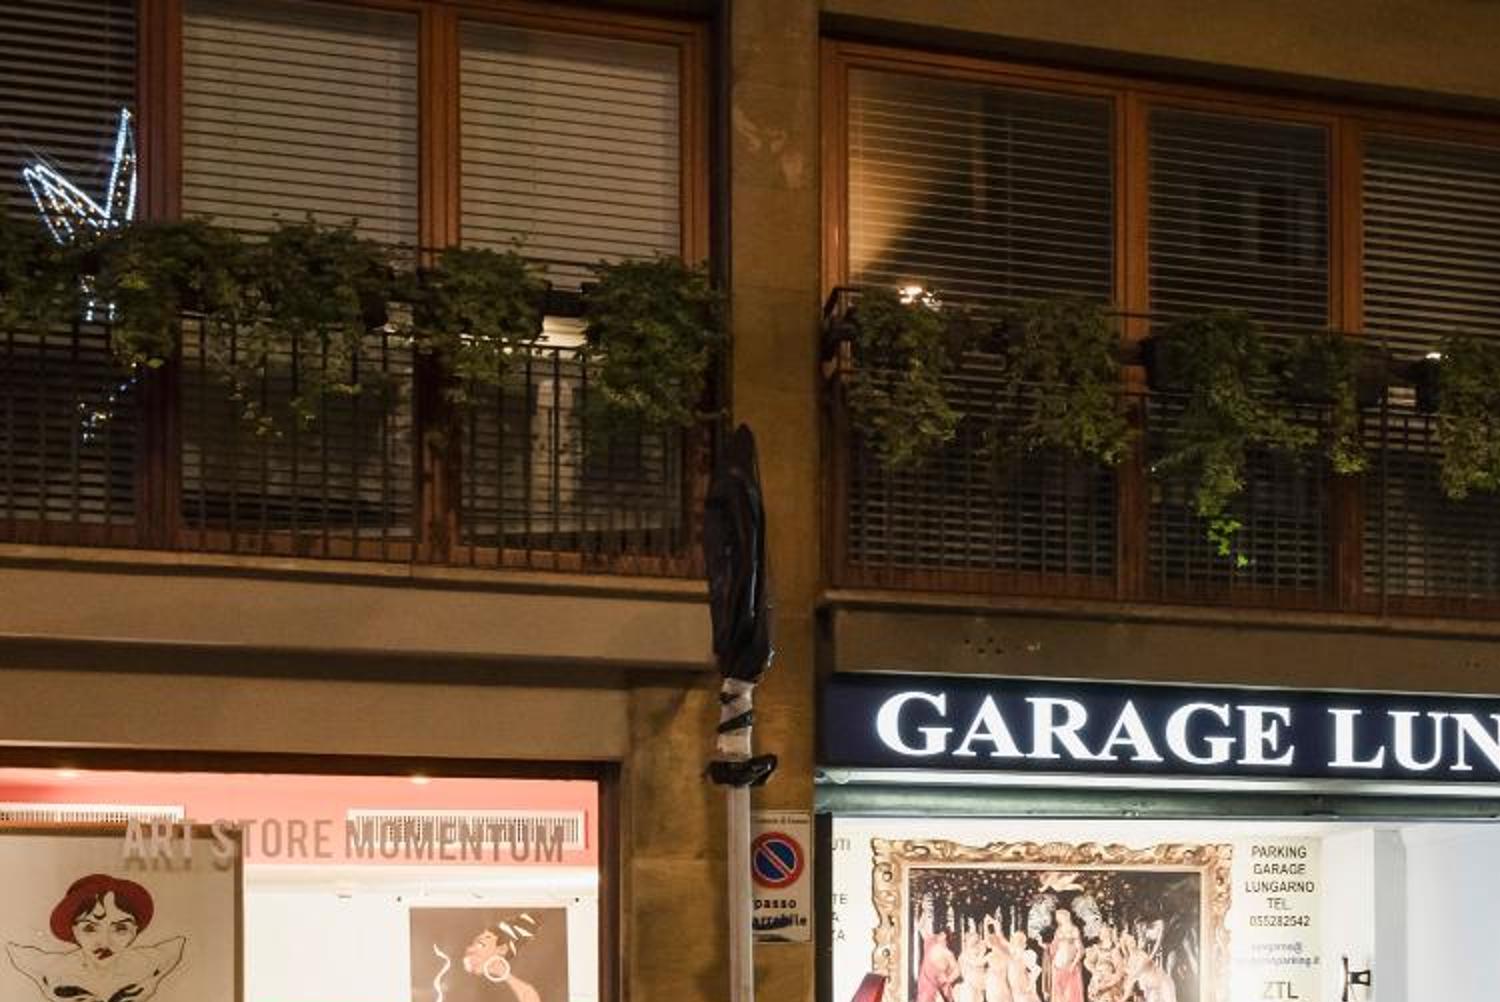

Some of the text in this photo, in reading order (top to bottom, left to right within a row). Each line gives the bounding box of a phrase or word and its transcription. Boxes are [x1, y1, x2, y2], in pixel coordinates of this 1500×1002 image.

[876, 690, 1295, 766] GARAGE
[120, 816, 566, 863] ART STORE MOMENTUM
[1251, 845, 1307, 859] PARKING
[1253, 863, 1306, 876] GARAGE
[1245, 880, 1315, 894] LUNGARNO
[754, 899, 797, 909] passo
[1249, 915, 1311, 928] 055282542
[1263, 980, 1299, 999] ZTL
